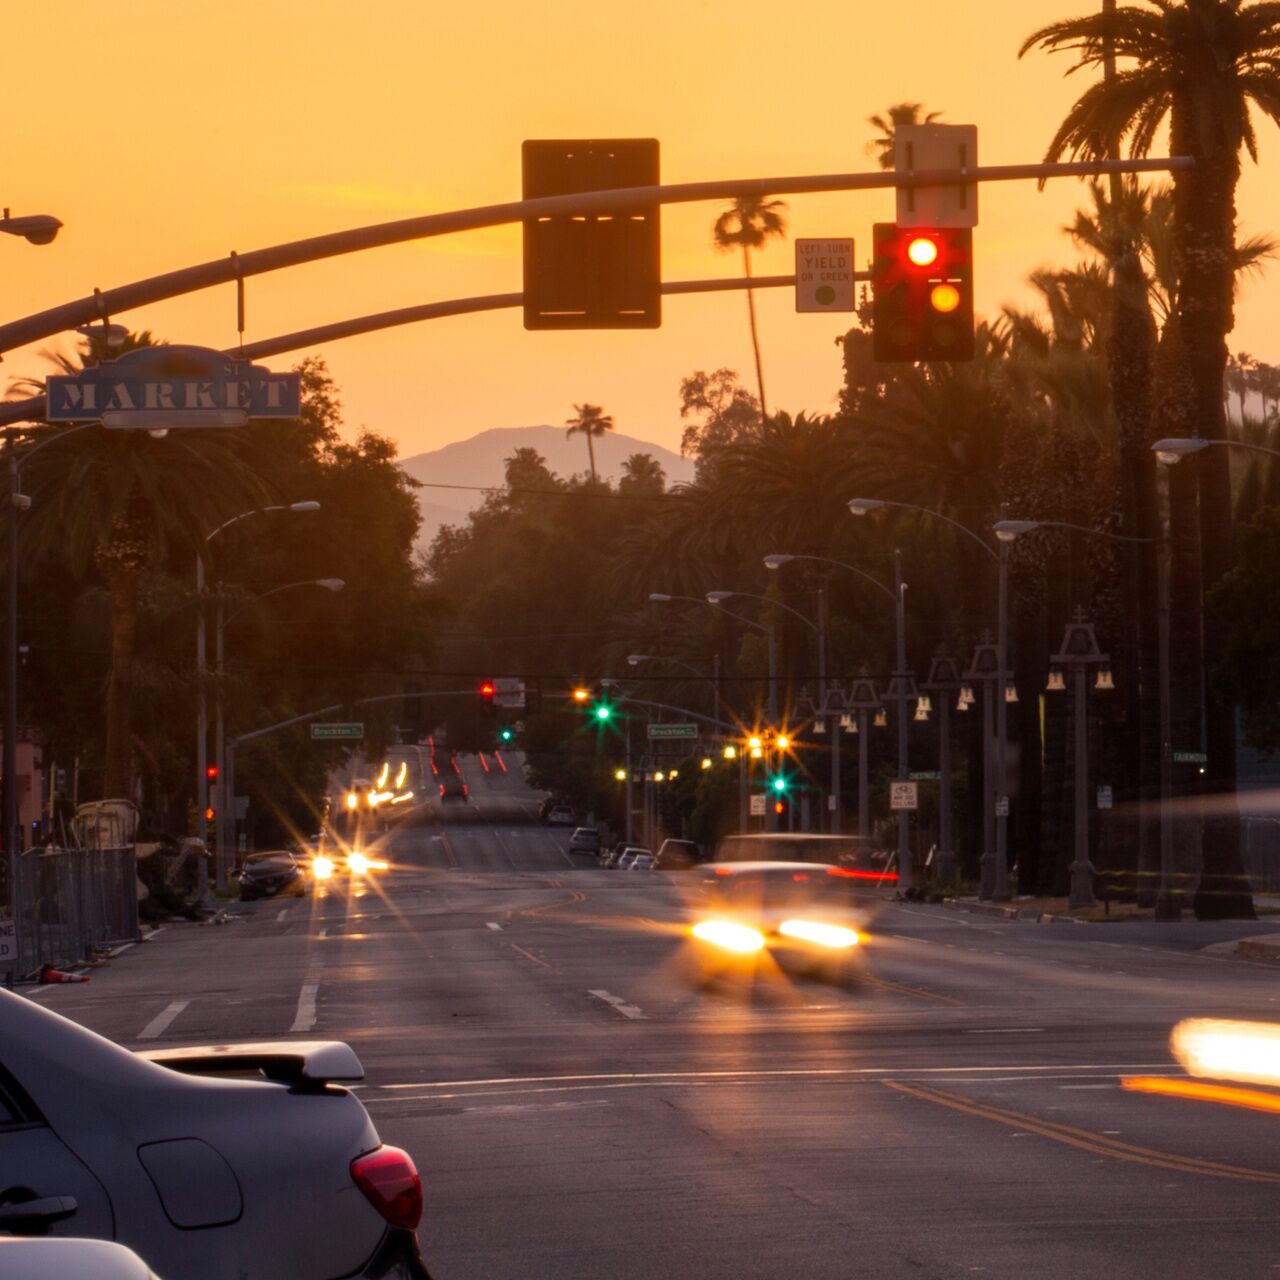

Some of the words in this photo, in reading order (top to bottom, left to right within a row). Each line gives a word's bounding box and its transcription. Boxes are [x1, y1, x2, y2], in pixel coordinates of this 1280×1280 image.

[800, 244, 820, 254] LEFT
[827, 243, 850, 253] TURN
[804, 257, 846, 269] YIELD
[801, 272, 814, 281] ON
[820, 271, 849, 281] GREEN
[223, 364, 241, 376] ST
[61, 380, 288, 410] MARKET
